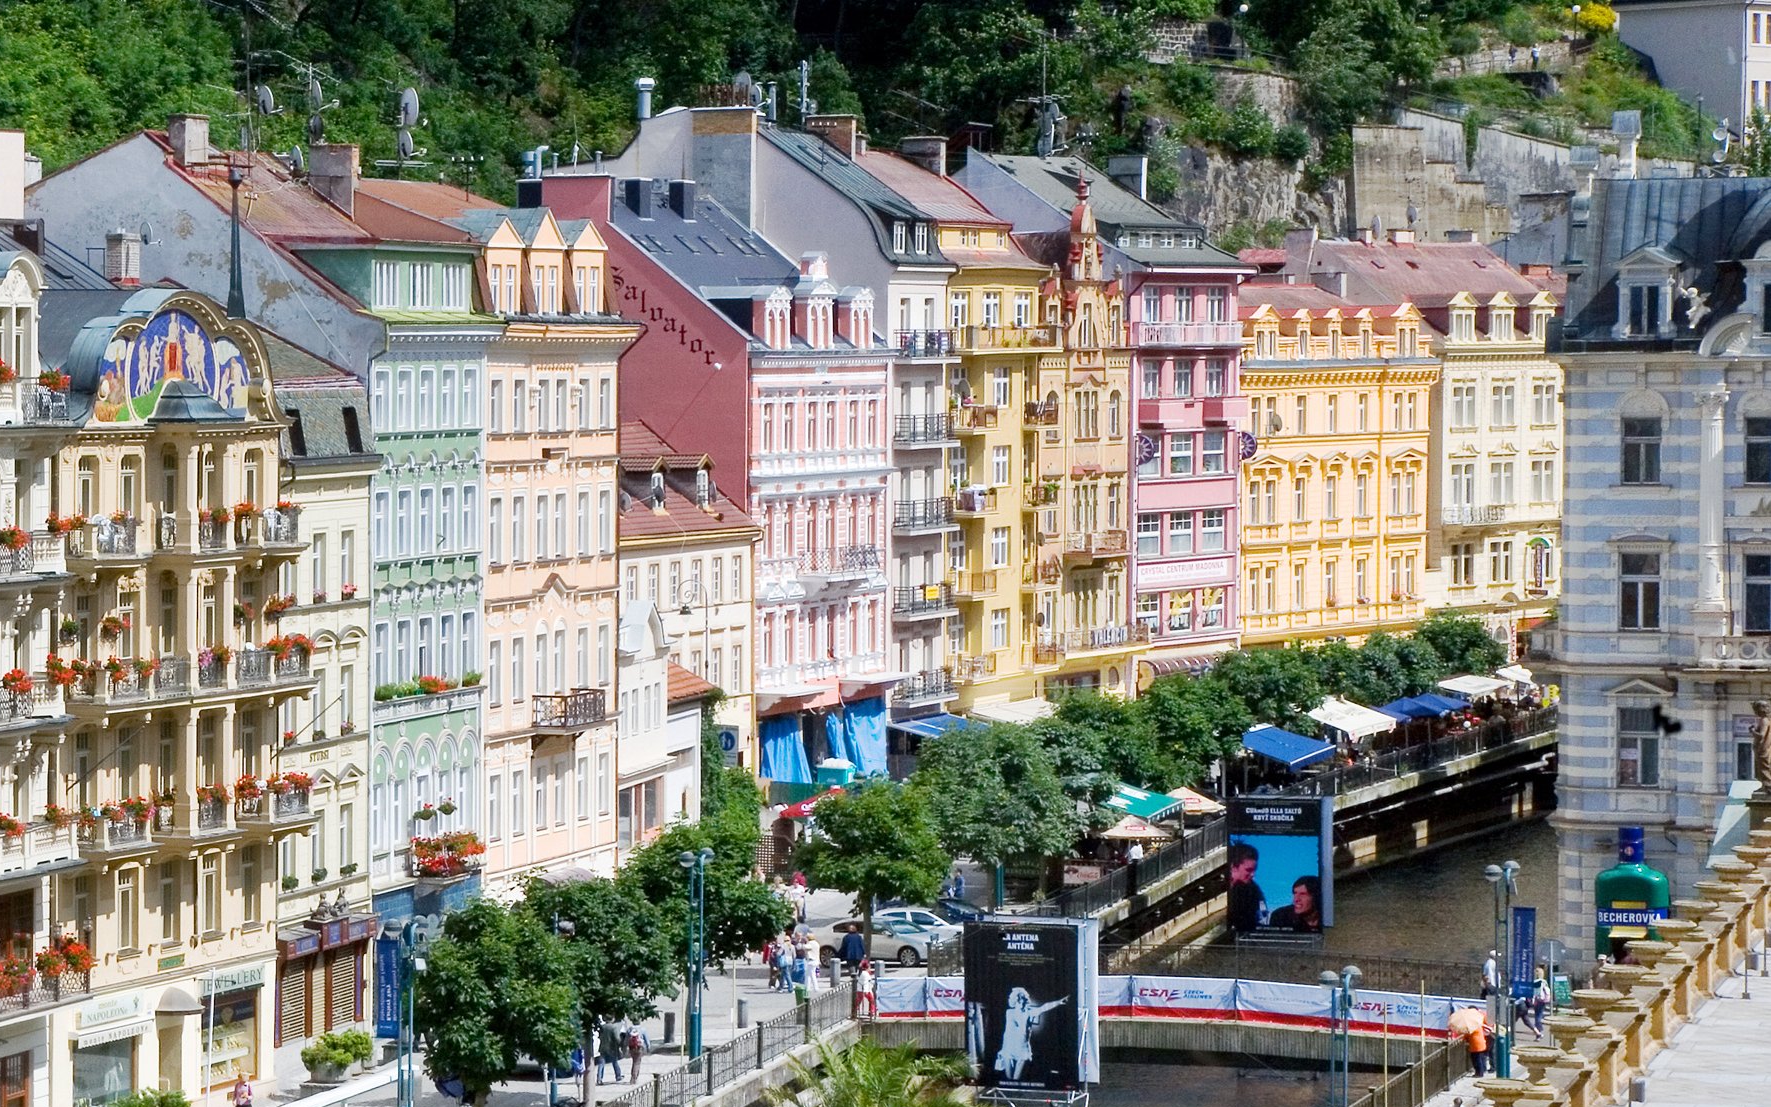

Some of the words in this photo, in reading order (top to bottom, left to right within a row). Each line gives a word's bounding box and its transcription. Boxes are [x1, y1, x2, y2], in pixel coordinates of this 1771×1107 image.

[1140, 567, 1165, 576] CRYSTAL
[1166, 564, 1194, 574] CENTRUM
[1195, 561, 1224, 570] MADONNA
[1598, 912, 1661, 924] BECHEROVKA
[1012, 934, 1039, 942] ANTENA
[203, 968, 264, 992] JEWELLERY
